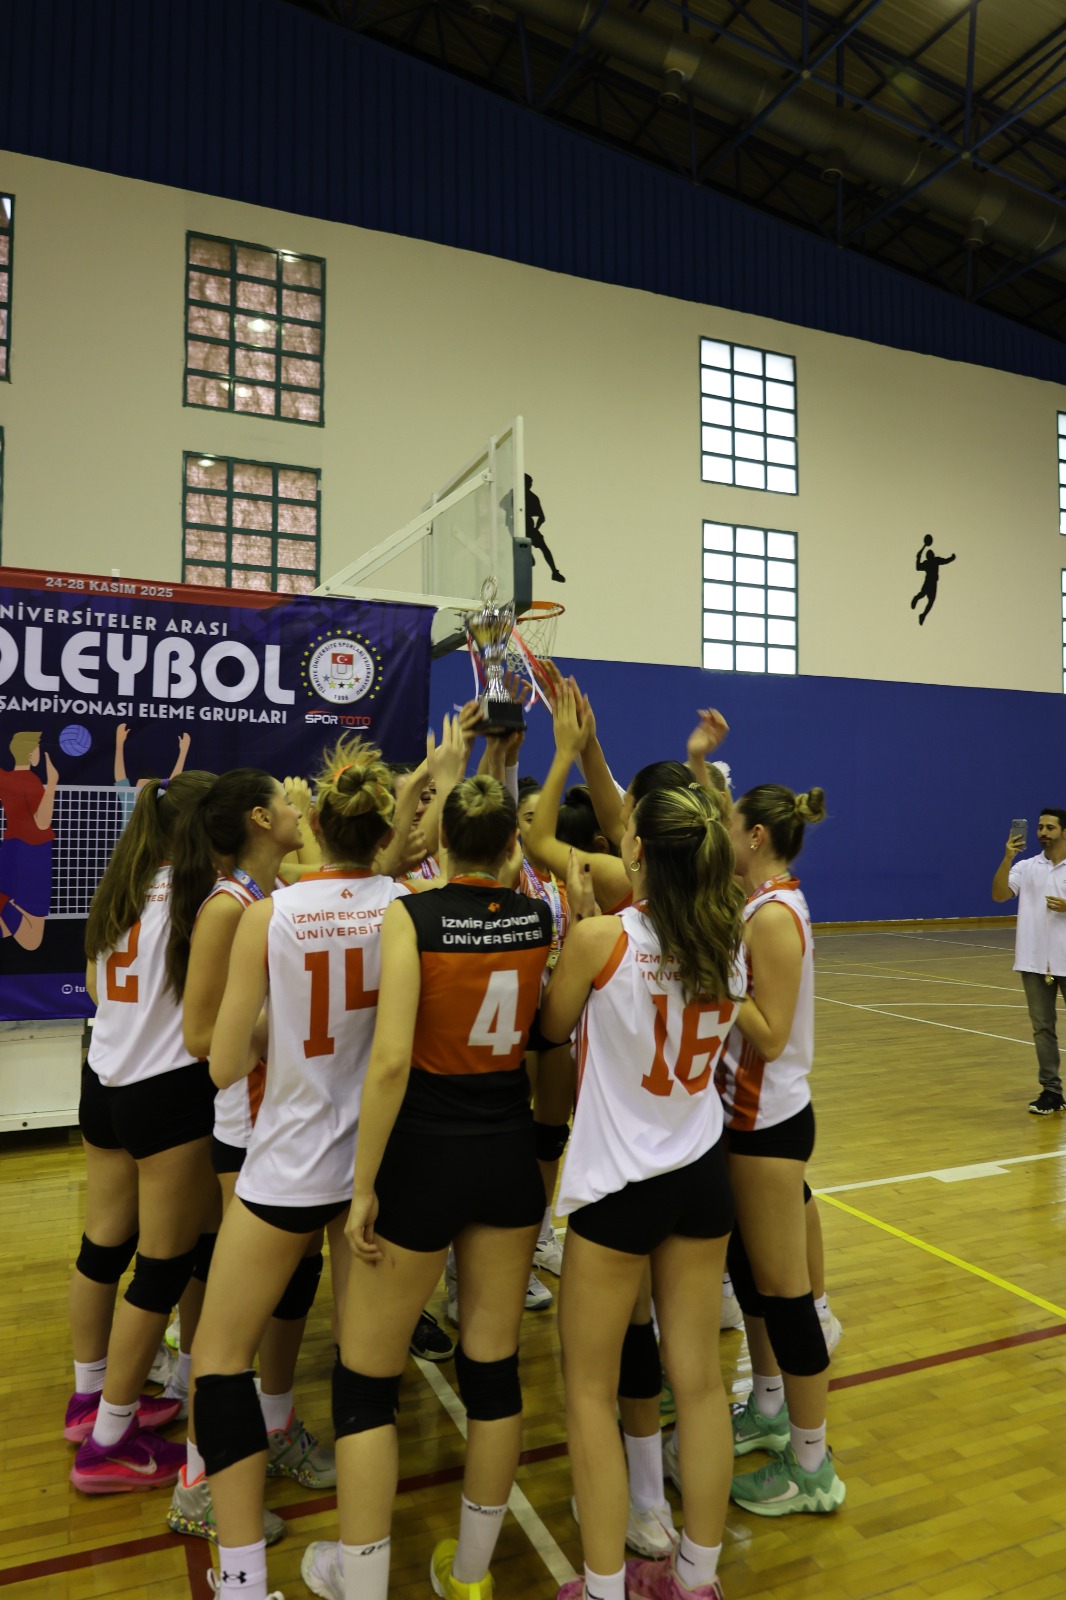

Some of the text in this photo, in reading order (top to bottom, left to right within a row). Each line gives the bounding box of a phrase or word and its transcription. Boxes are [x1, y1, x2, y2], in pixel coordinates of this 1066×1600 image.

[45, 577, 174, 598] 24-28 KASIM 2025
[165, 618, 228, 637] ARASI
[139, 703, 195, 720] ELEME
[199, 706, 287, 724] GRUPLARI
[291, 909, 336, 924] İZMİR
[441, 916, 483, 930] İZMİR
[484, 912, 540, 930] EKONOMİ
[442, 926, 543, 945] ÜNİVERSİTESİ
[467, 969, 523, 1056] 4
[640, 993, 735, 1097] 16
